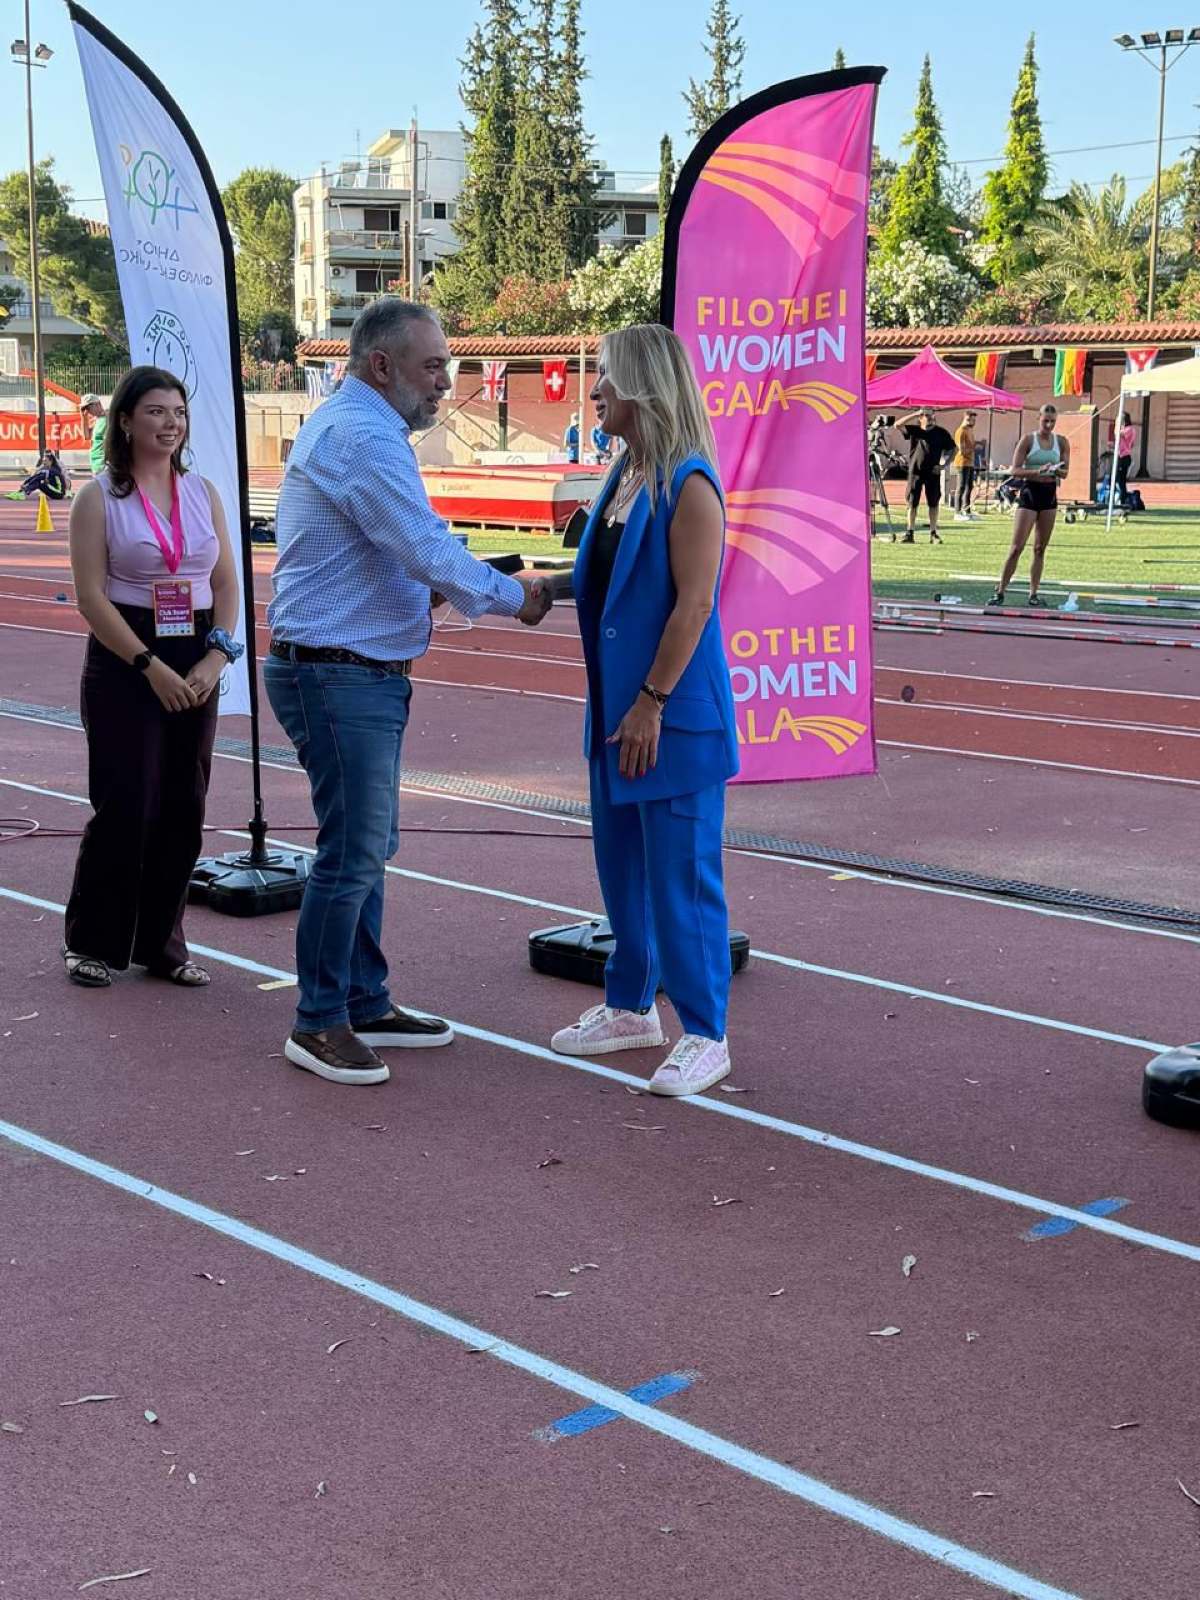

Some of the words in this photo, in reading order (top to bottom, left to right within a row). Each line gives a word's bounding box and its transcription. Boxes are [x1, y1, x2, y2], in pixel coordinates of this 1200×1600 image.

[697, 289, 846, 327] FILOTHEI
[0, 422, 25, 440] UN
[30, 423, 84, 441] CEAN
[730, 624, 856, 658] OTHEI
[730, 660, 856, 702] OMEN
